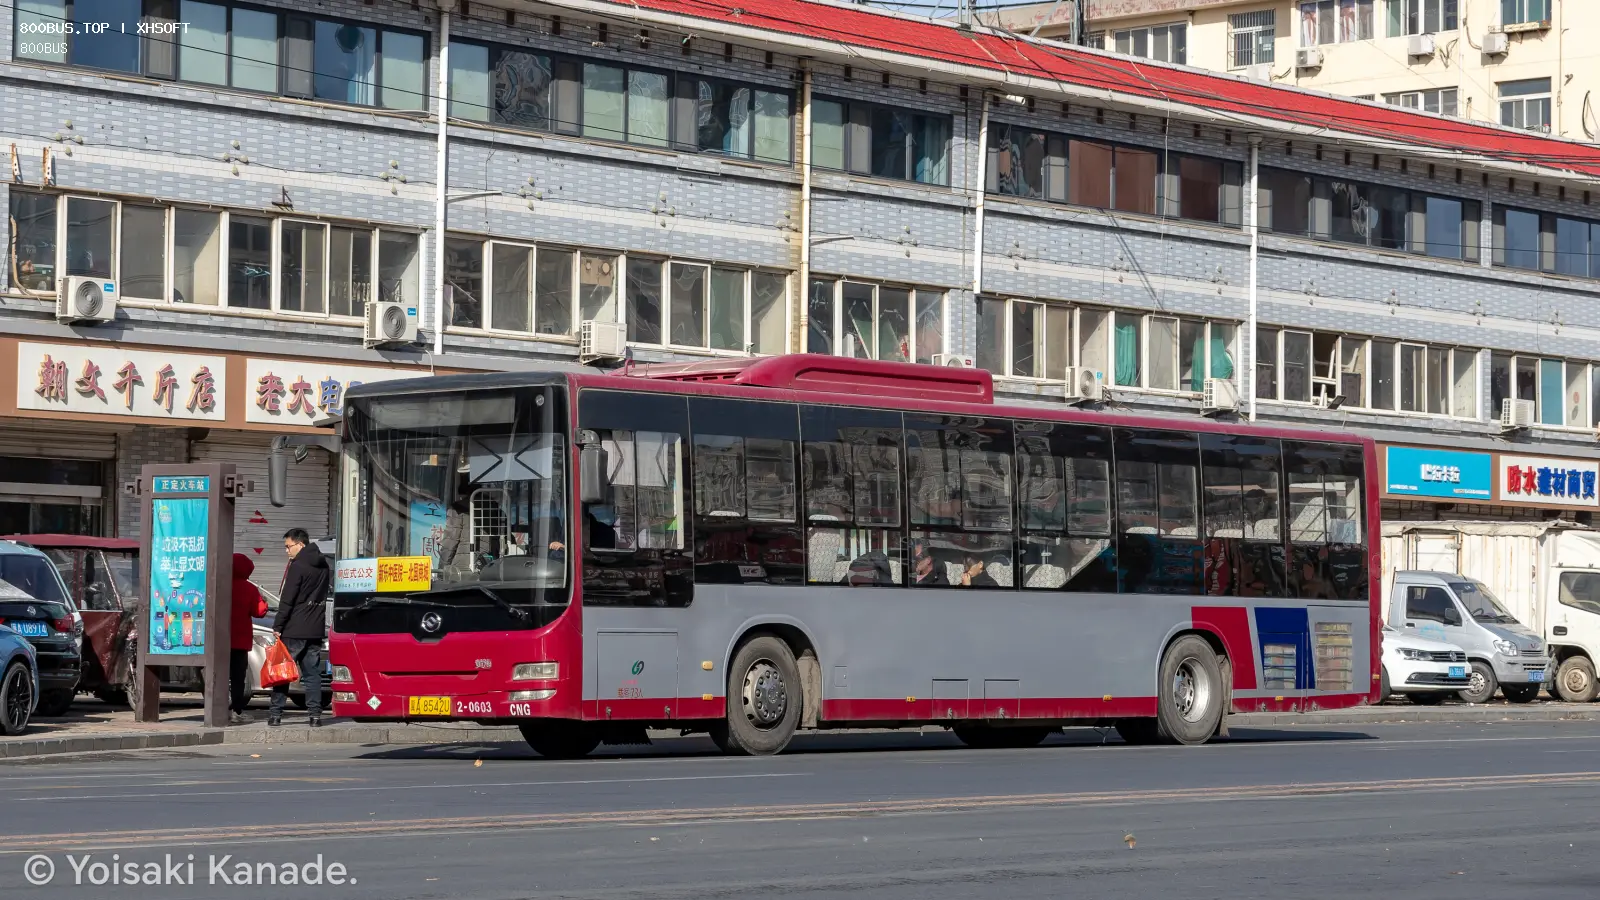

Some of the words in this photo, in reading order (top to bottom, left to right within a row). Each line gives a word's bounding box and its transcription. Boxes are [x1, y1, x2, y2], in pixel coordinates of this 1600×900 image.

[161, 480, 204, 490] 正定火车站
[1507, 465, 1595, 498] 防水建材商贸
[162, 536, 205, 553] 垃圾不乱扔
[160, 556, 205, 572] 举止显文明
[457, 701, 492, 713] 2-0603
[510, 704, 531, 716] CNG
